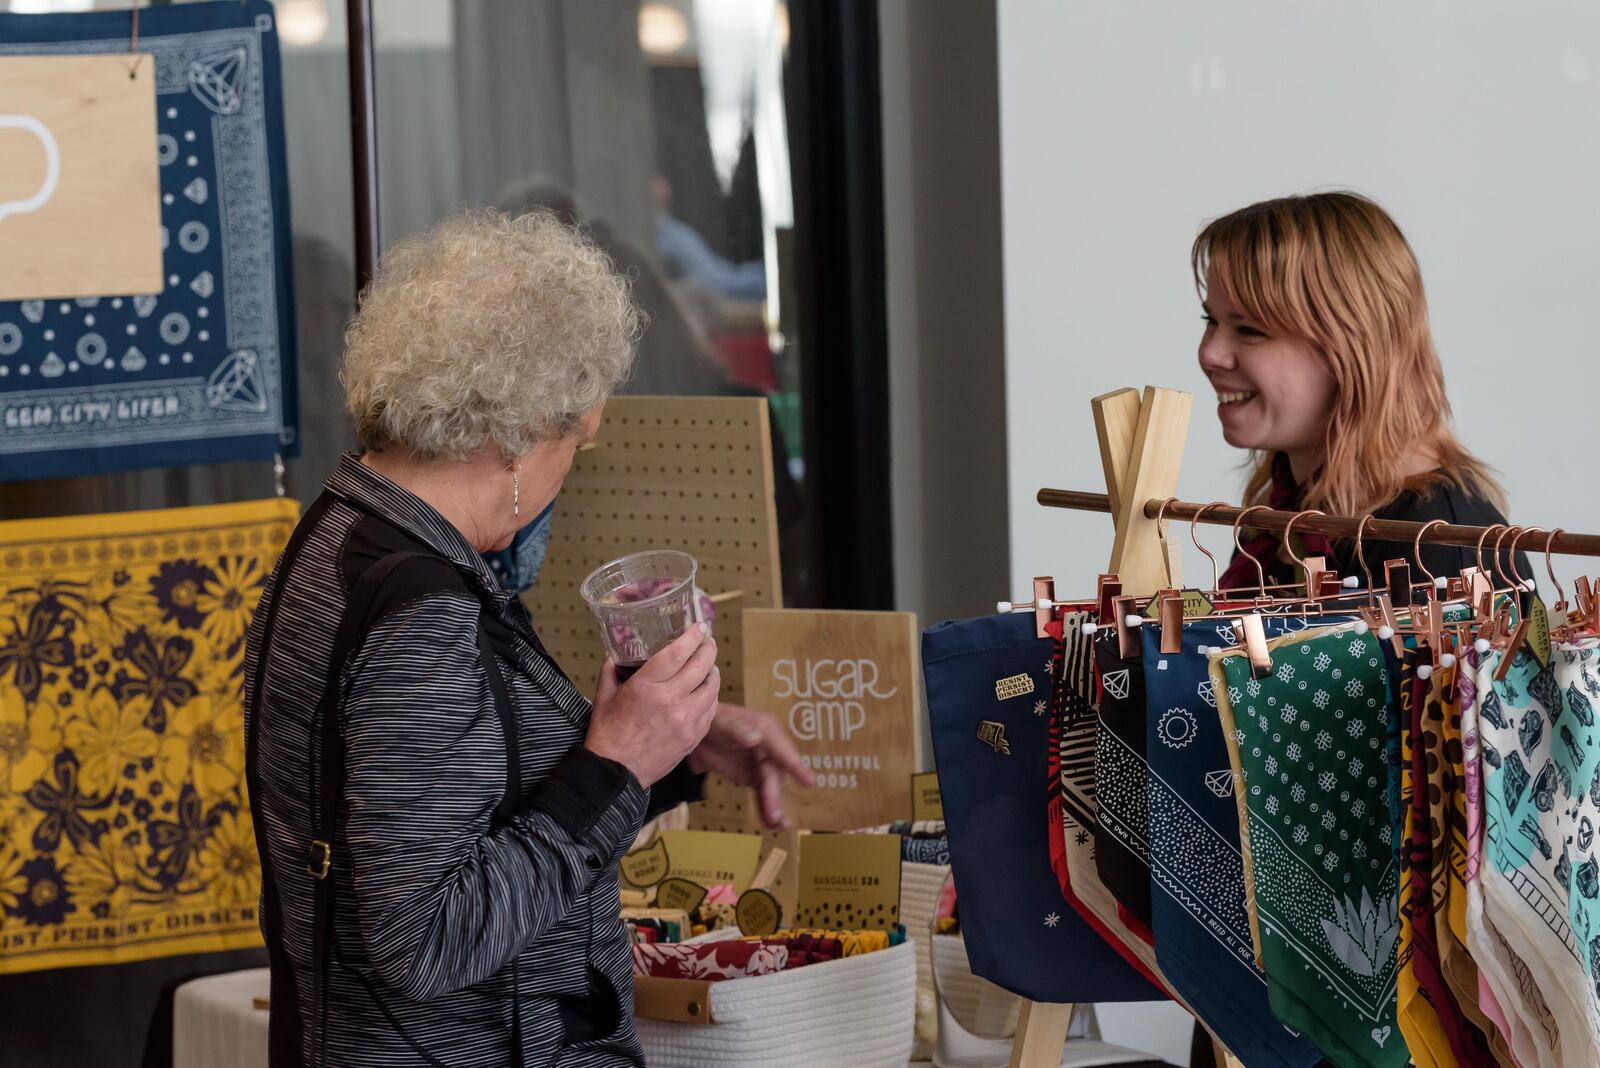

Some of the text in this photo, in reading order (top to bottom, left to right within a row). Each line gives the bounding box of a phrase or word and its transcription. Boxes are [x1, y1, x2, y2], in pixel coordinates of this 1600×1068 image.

[60, 403, 111, 423] CITY
[117, 396, 179, 418] LIFER
[997, 680, 1031, 693] PERSIST
[998, 674, 1027, 687] RESIST
[998, 685, 1033, 699] DISSENT
[801, 755, 880, 770] OUGHTFUL
[816, 774, 858, 788] OODS
[1100, 812, 1129, 839] OUR OWN
[671, 868, 713, 879] ANDANAS
[813, 875, 880, 886] BANDANAS $26
[2, 932, 41, 948] IST
[166, 909, 255, 929] DISSEN
[1208, 918, 1226, 936] BREED
[1226, 935, 1237, 948] ALL
[1238, 947, 1251, 960] OUR
